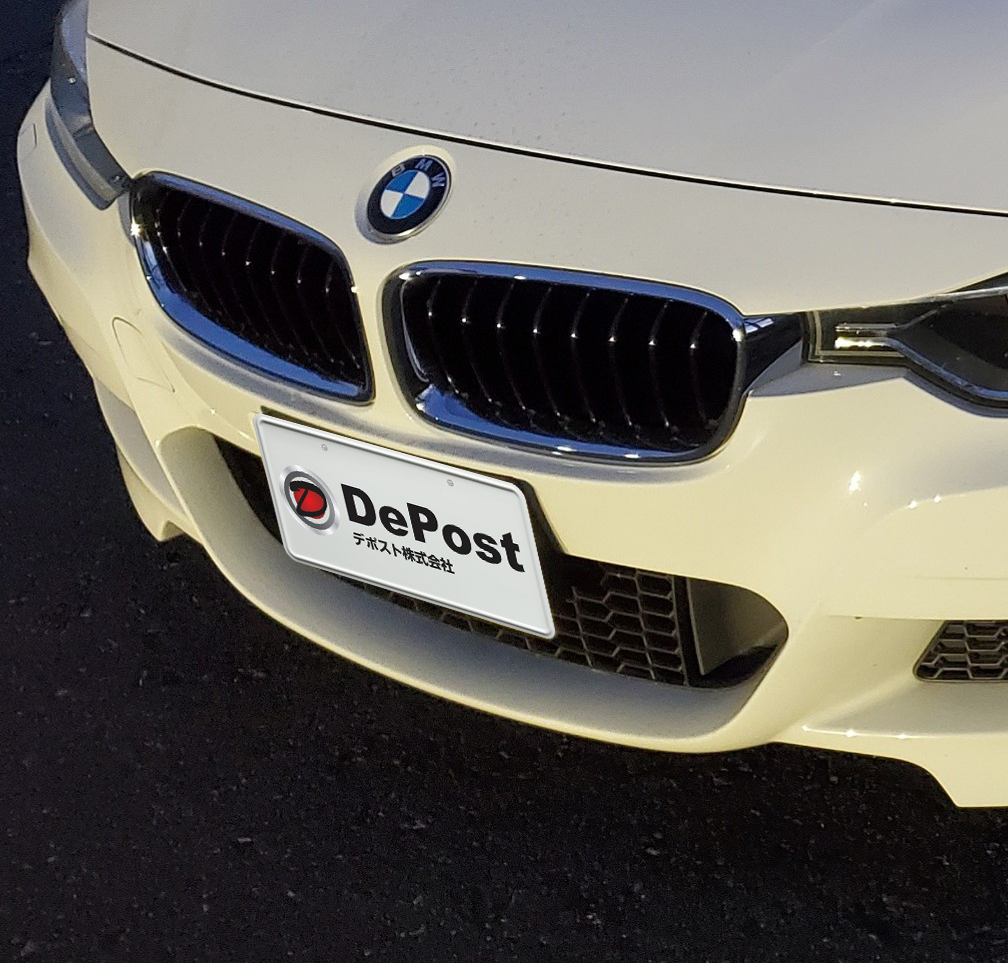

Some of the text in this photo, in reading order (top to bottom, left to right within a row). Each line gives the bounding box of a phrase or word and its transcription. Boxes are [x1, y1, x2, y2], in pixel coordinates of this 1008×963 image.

[391, 158, 446, 188] BMW
[340, 483, 525, 573] DePost
[352, 531, 456, 575] デポスト株式会社
